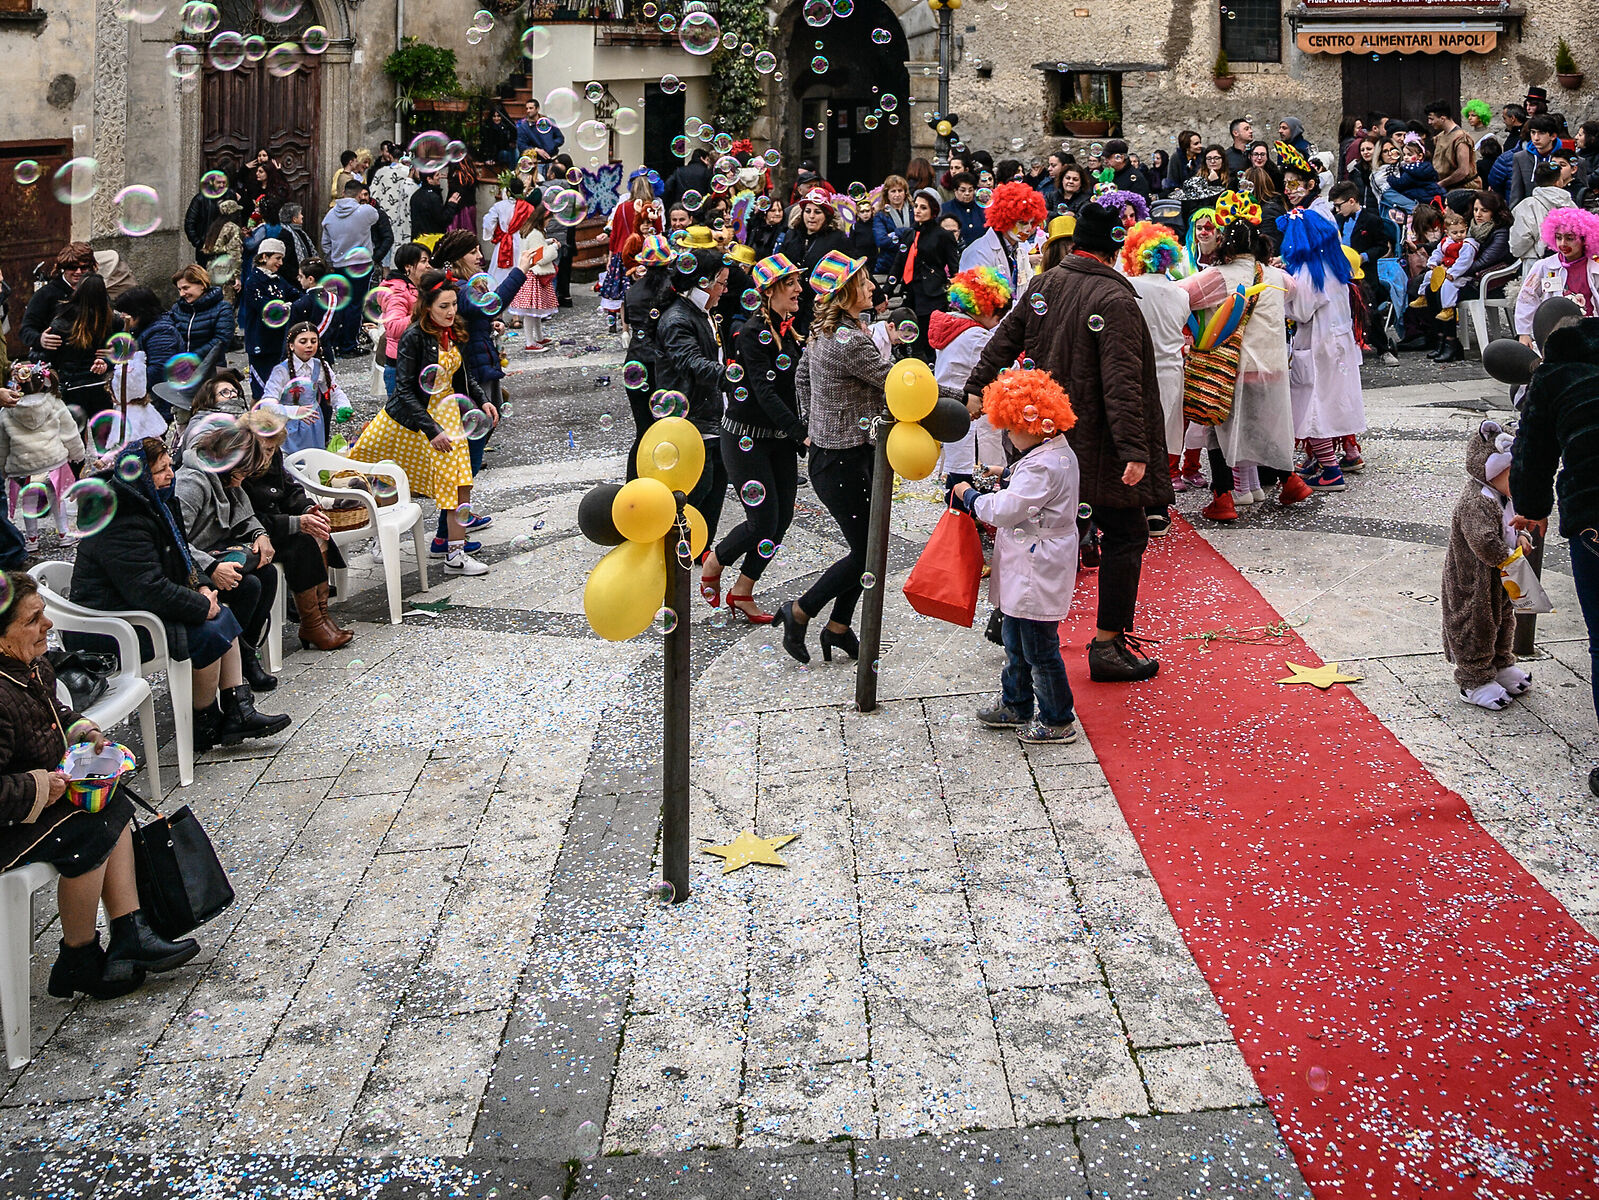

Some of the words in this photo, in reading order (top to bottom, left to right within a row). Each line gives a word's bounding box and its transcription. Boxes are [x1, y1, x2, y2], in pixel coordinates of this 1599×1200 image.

[1308, 35, 1355, 47] CENTRO
[1360, 34, 1433, 47] ALIMENTARI
[1439, 34, 1486, 46] NAPOLI
